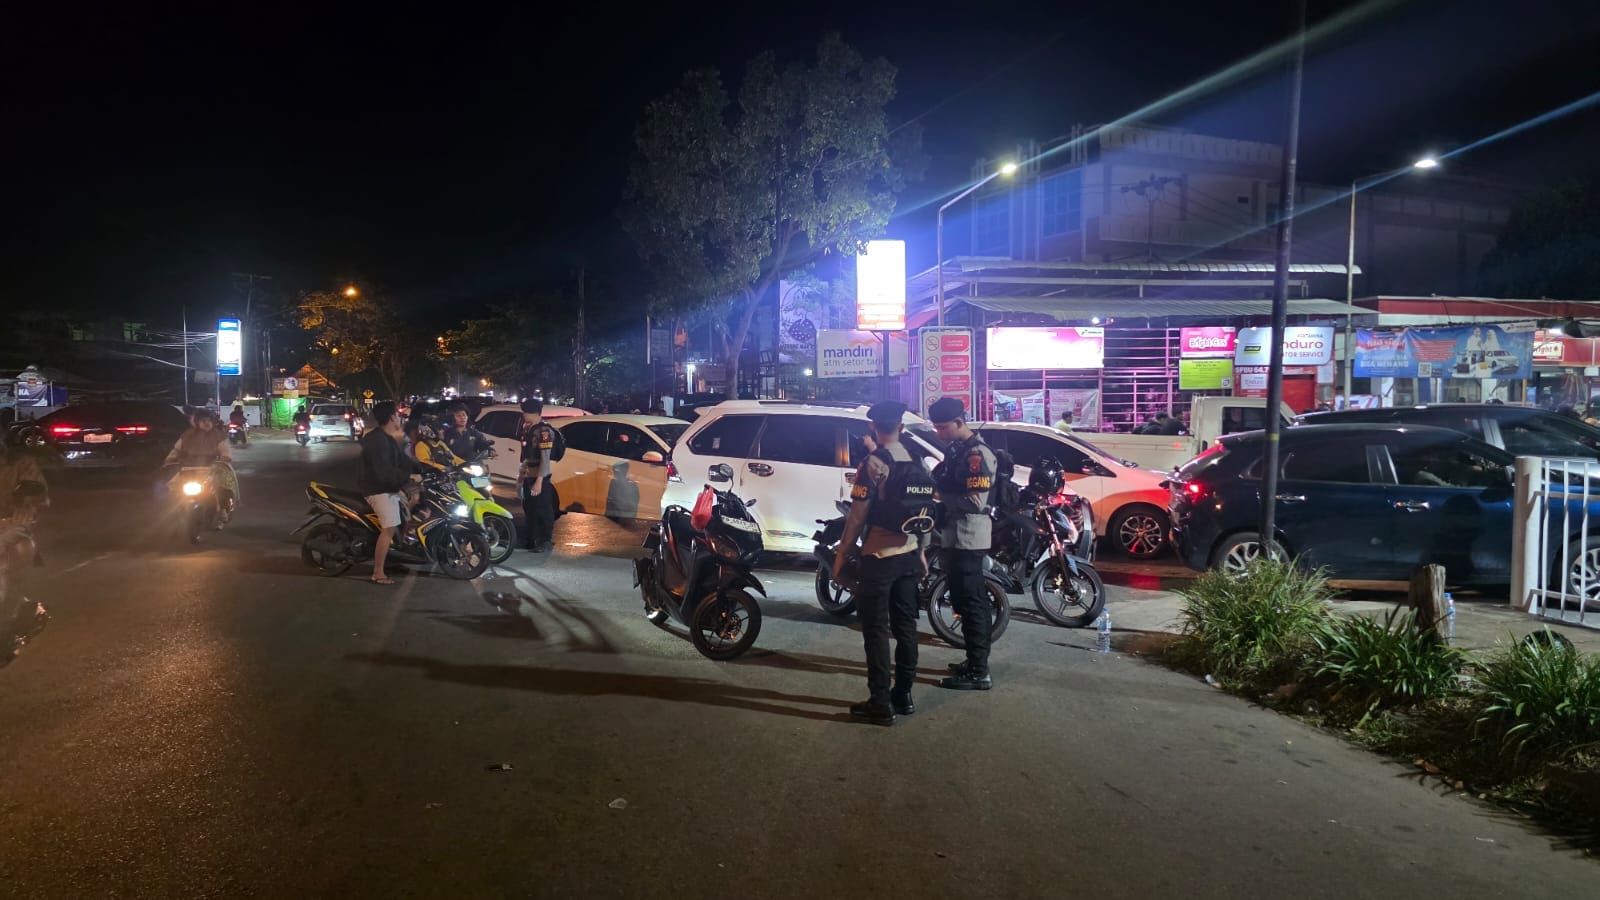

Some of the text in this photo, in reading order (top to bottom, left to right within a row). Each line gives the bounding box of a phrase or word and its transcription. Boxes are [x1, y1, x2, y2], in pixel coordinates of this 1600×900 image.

[1283, 339, 1324, 349] nduro
[823, 345, 873, 359] mandiri
[823, 358, 840, 368] atm
[842, 358, 864, 367] setor
[966, 476, 991, 489] GGANG
[906, 486, 933, 495] POLISI
